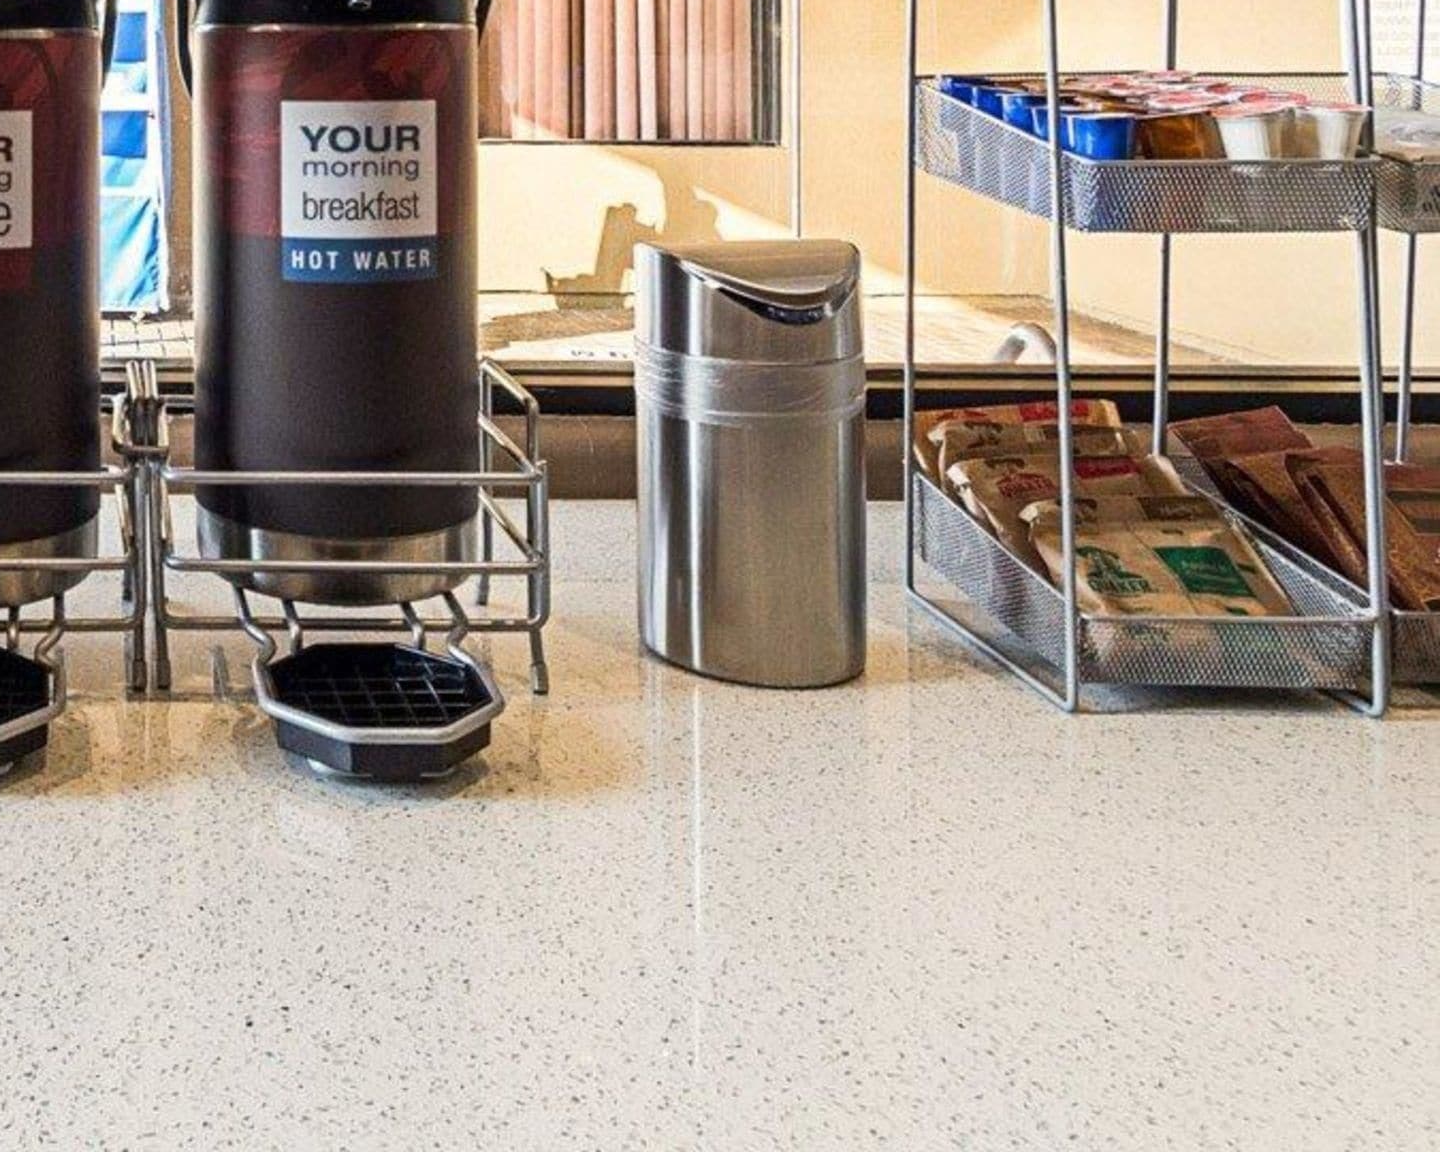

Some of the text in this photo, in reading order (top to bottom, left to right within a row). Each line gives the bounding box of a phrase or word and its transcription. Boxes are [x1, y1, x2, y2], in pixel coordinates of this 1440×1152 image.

[300, 125, 421, 153] YOUR
[302, 156, 421, 182] morning
[302, 190, 420, 222] breakfast
[291, 249, 432, 270] HOT WATER
